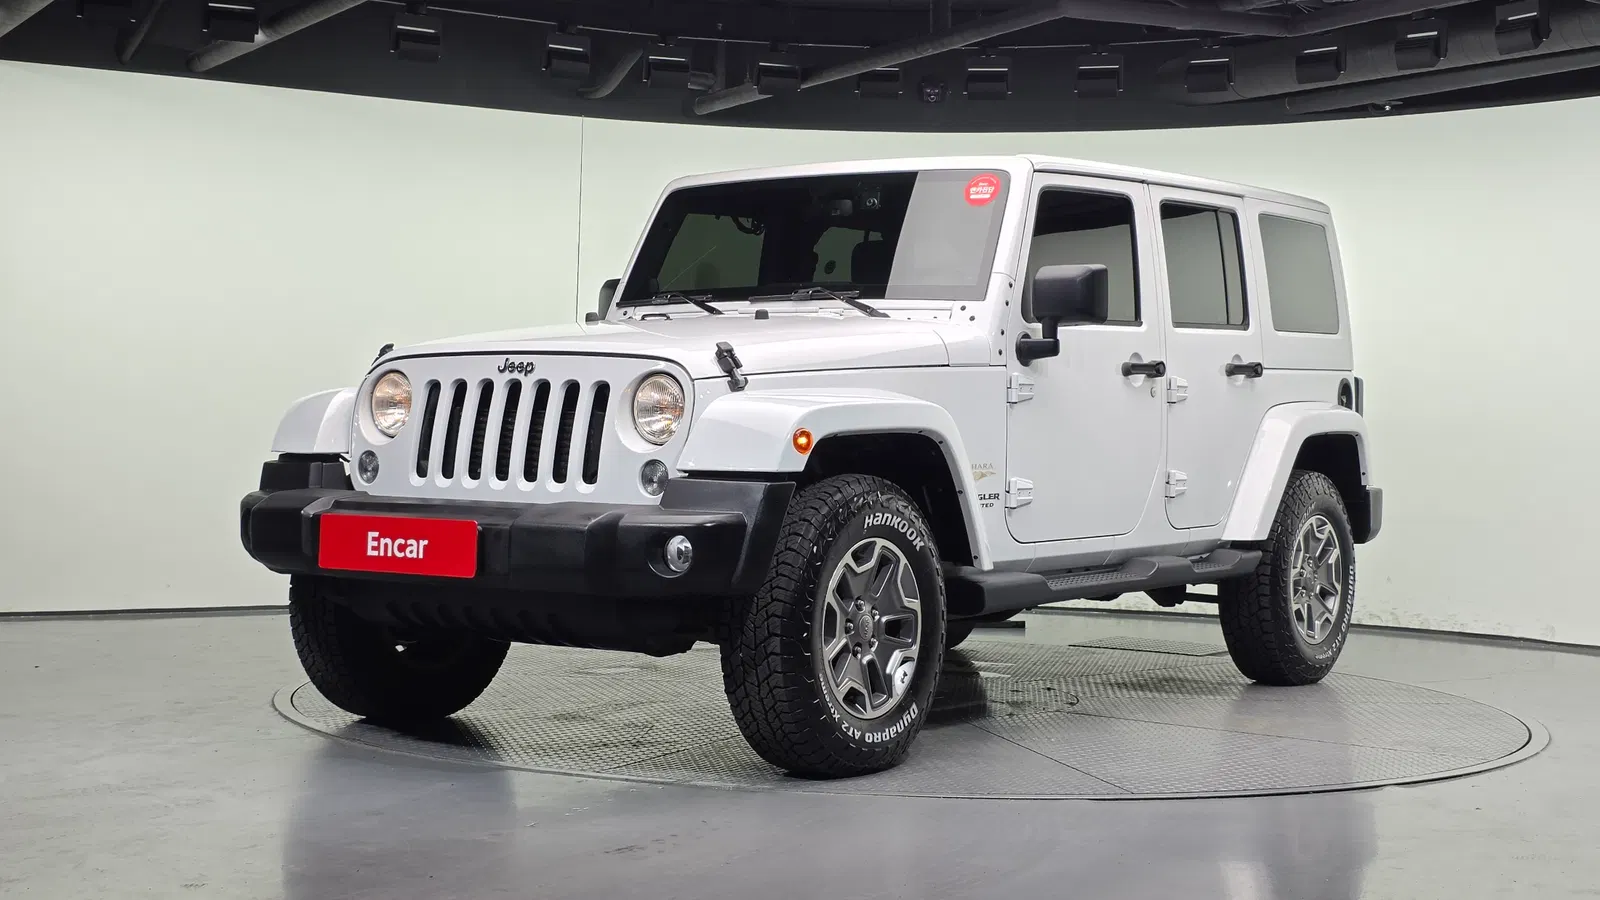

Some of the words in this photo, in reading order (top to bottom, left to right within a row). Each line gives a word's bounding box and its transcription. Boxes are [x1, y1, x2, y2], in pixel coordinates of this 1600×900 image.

[497, 357, 535, 377] Jeep
[978, 493, 1000, 501] GLER
[366, 531, 428, 559] Encar
[841, 720, 861, 740] AT2
